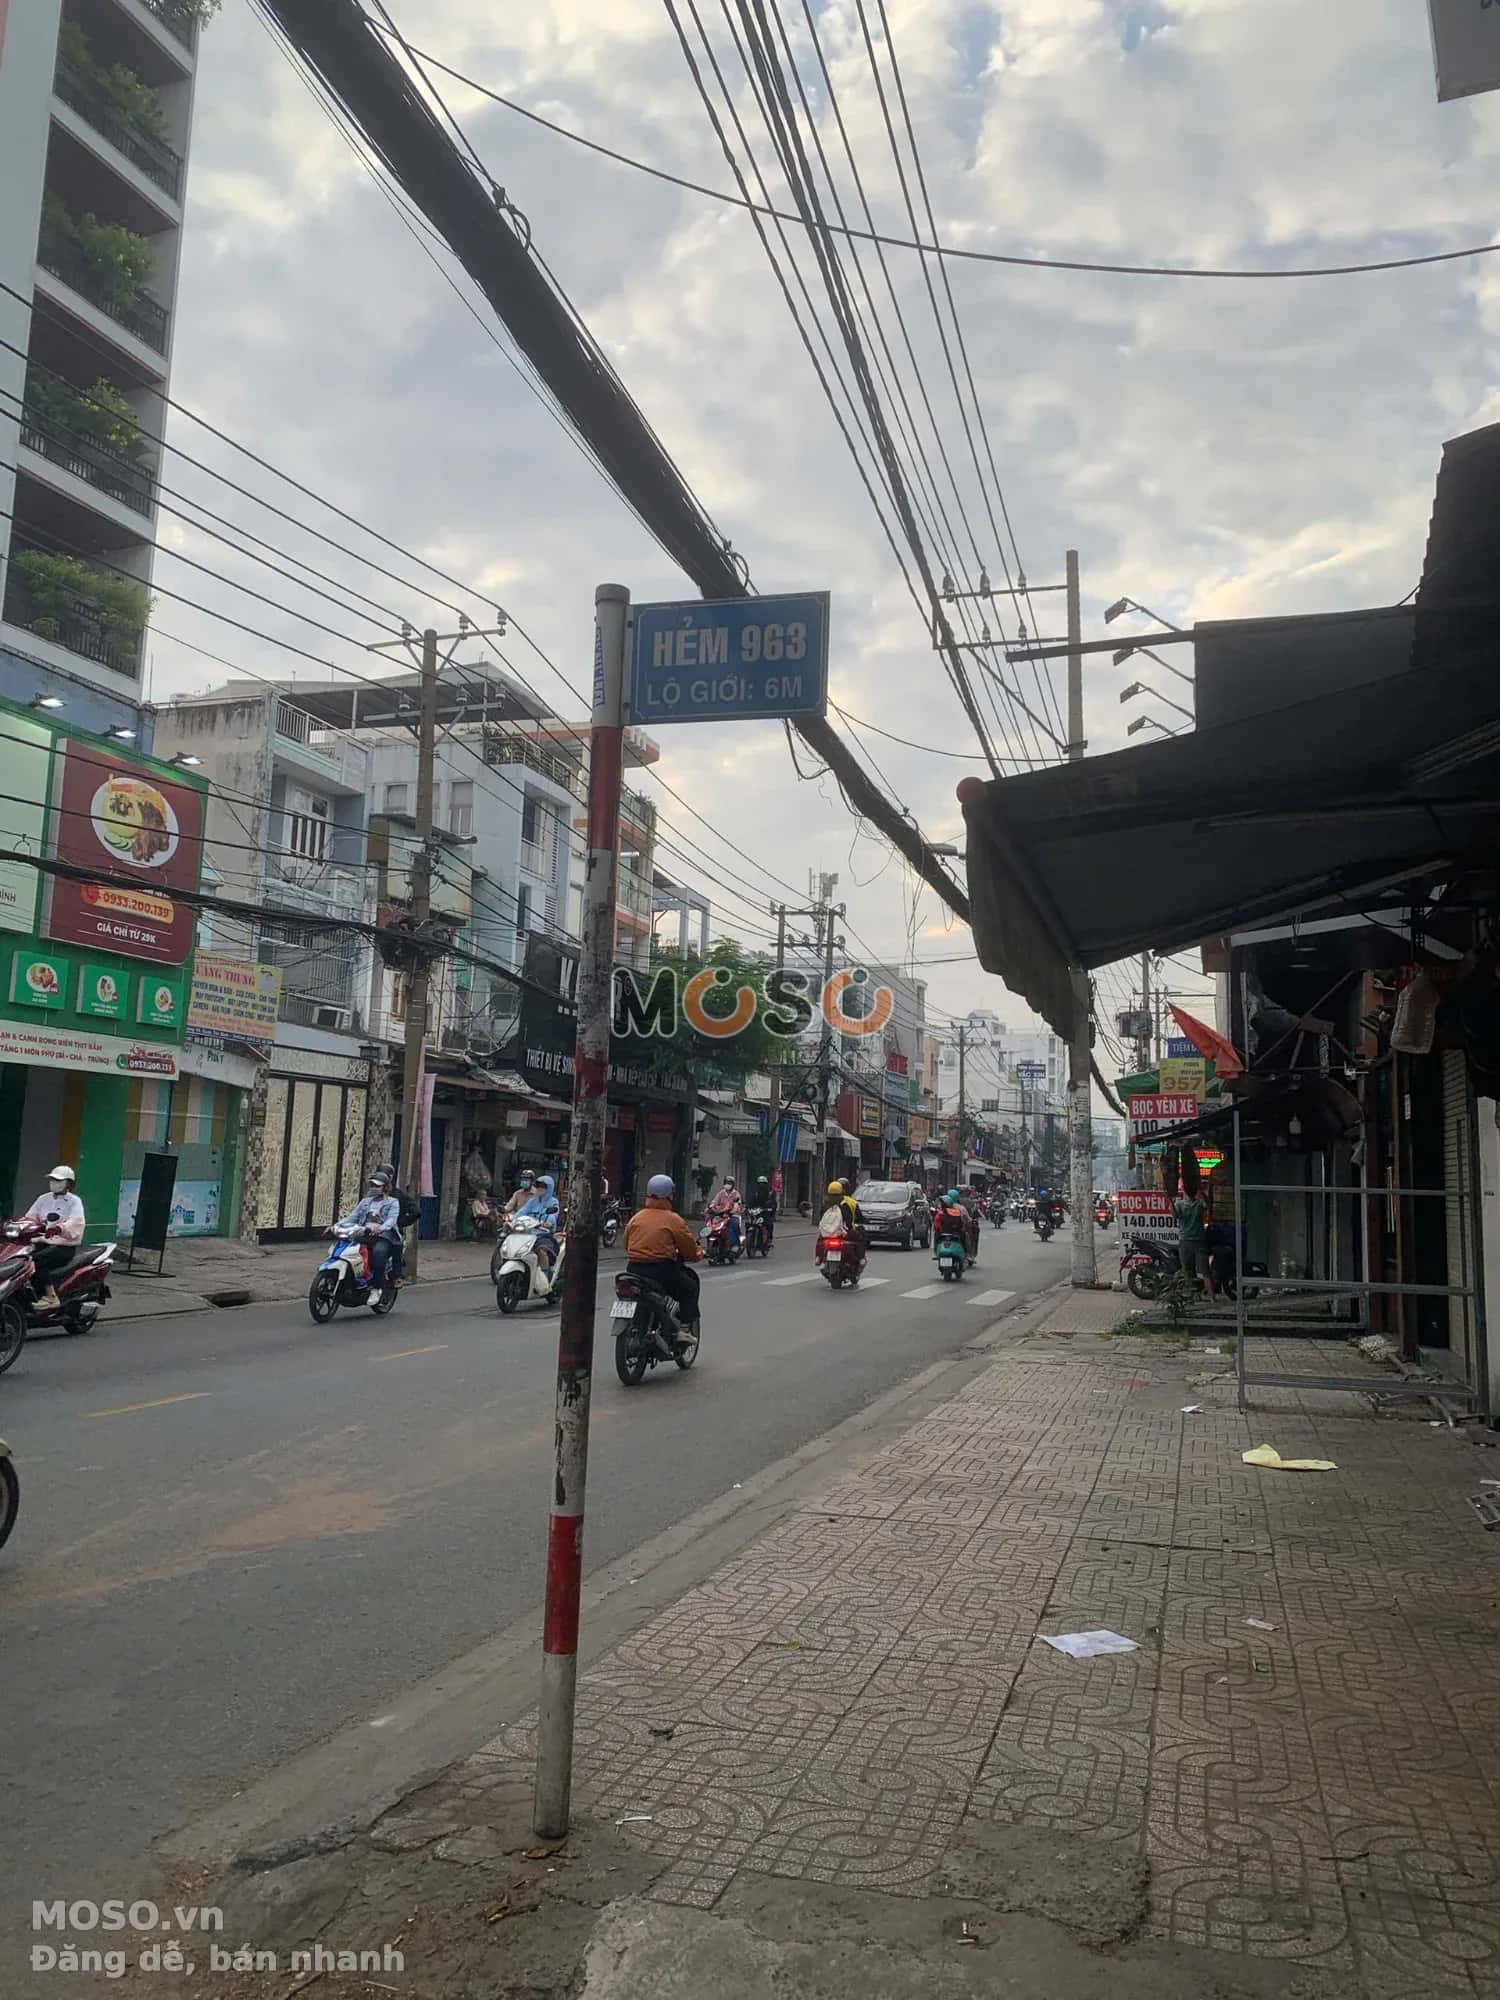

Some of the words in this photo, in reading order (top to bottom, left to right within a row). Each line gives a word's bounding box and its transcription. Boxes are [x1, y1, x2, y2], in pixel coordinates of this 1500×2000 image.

[653, 616, 728, 667] HẺM
[740, 622, 807, 662] 963
[647, 677, 681, 709] LỘ
[690, 671, 753, 702] GIỚI:
[765, 676, 801, 698] 6M
[97, 921, 112, 934] GIÁ
[1132, 1100, 1154, 1119] BỌC
[1156, 1096, 1177, 1114] YÊN
[1180, 1099, 1194, 1113] XE
[1121, 1196, 1142, 1213] BỌC
[1145, 1193, 1165, 1209] YÊN
